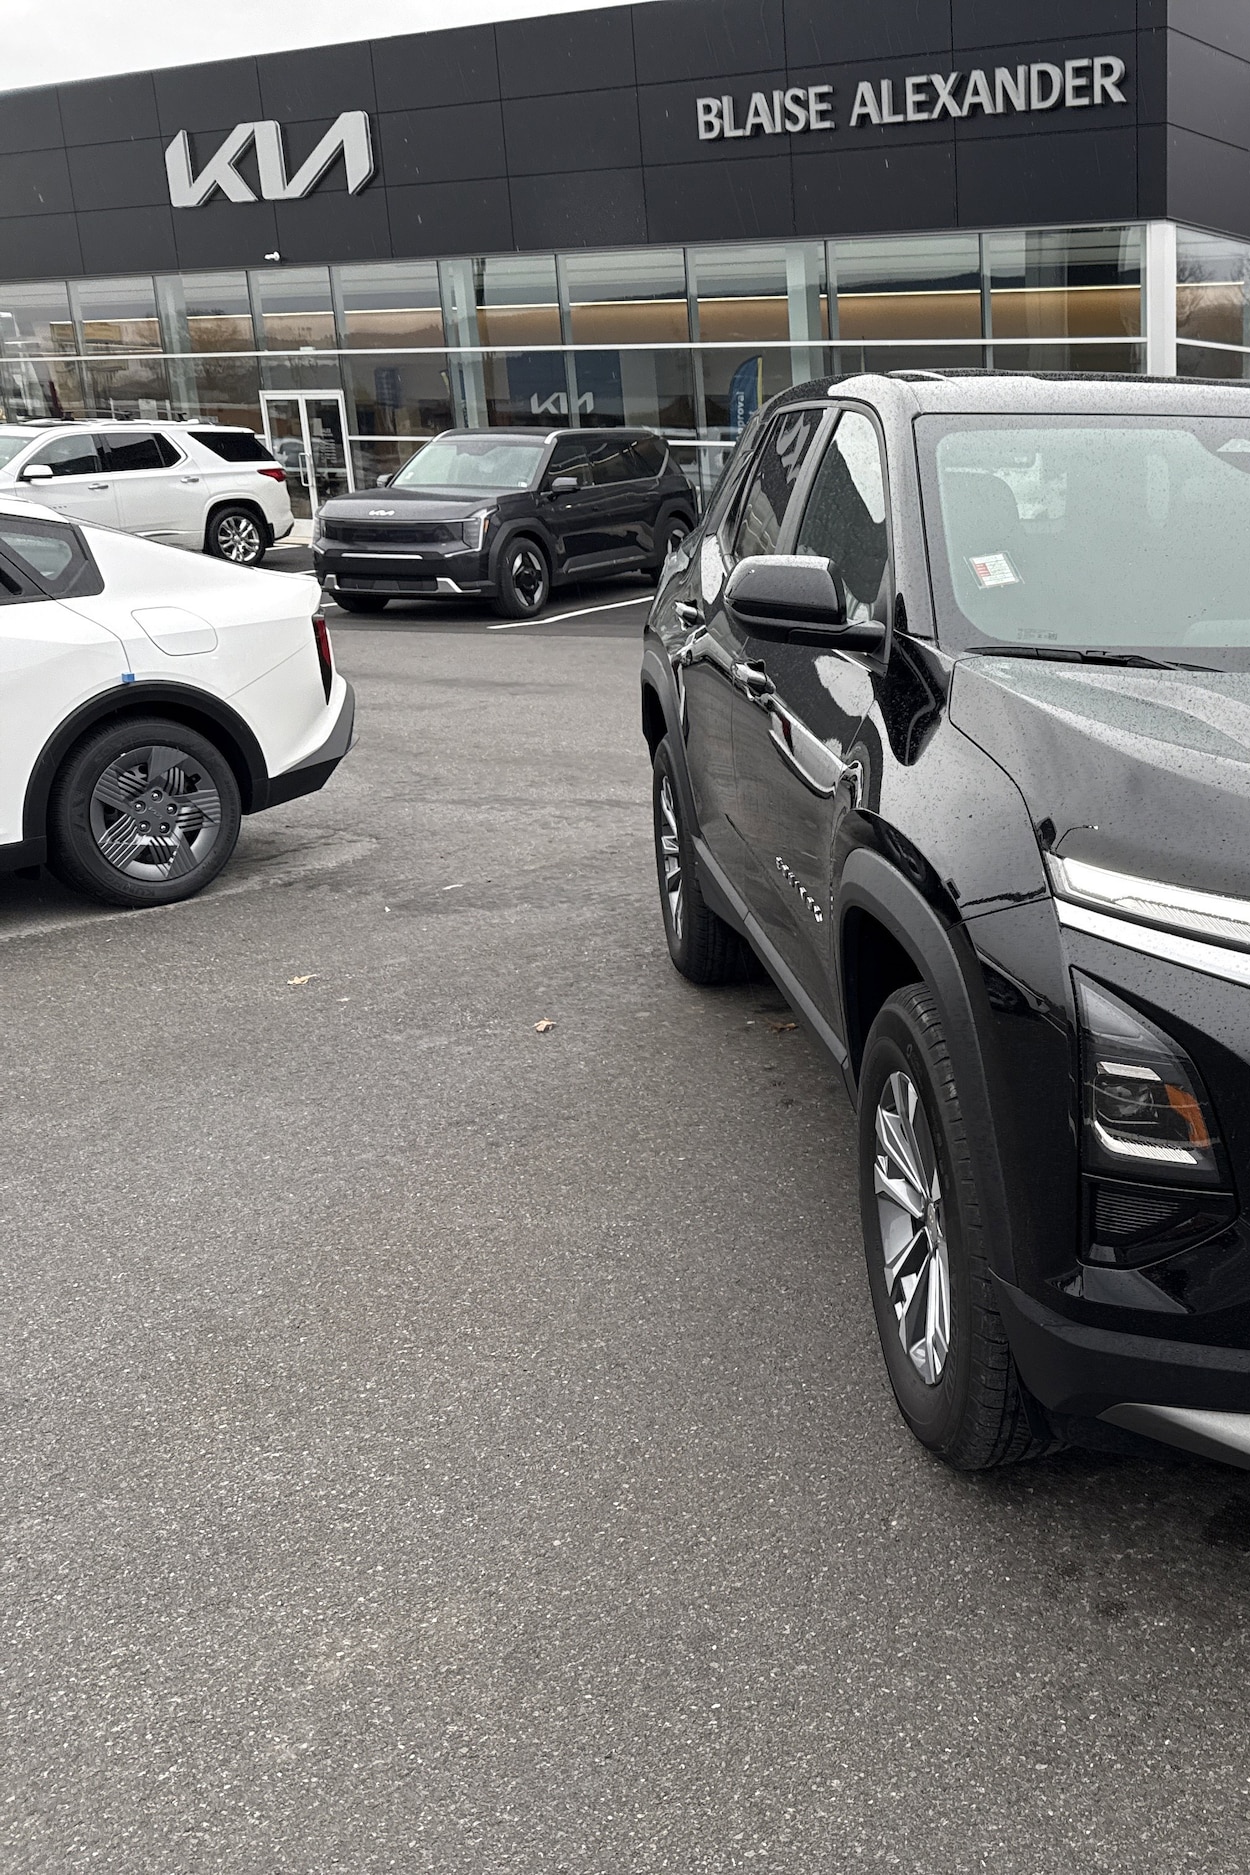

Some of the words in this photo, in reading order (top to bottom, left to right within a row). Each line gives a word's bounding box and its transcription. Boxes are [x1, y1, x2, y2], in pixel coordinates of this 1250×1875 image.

[696, 84, 835, 141] BLAISE
[850, 55, 1127, 127] ALEXANDER
[164, 110, 377, 208] KIA
